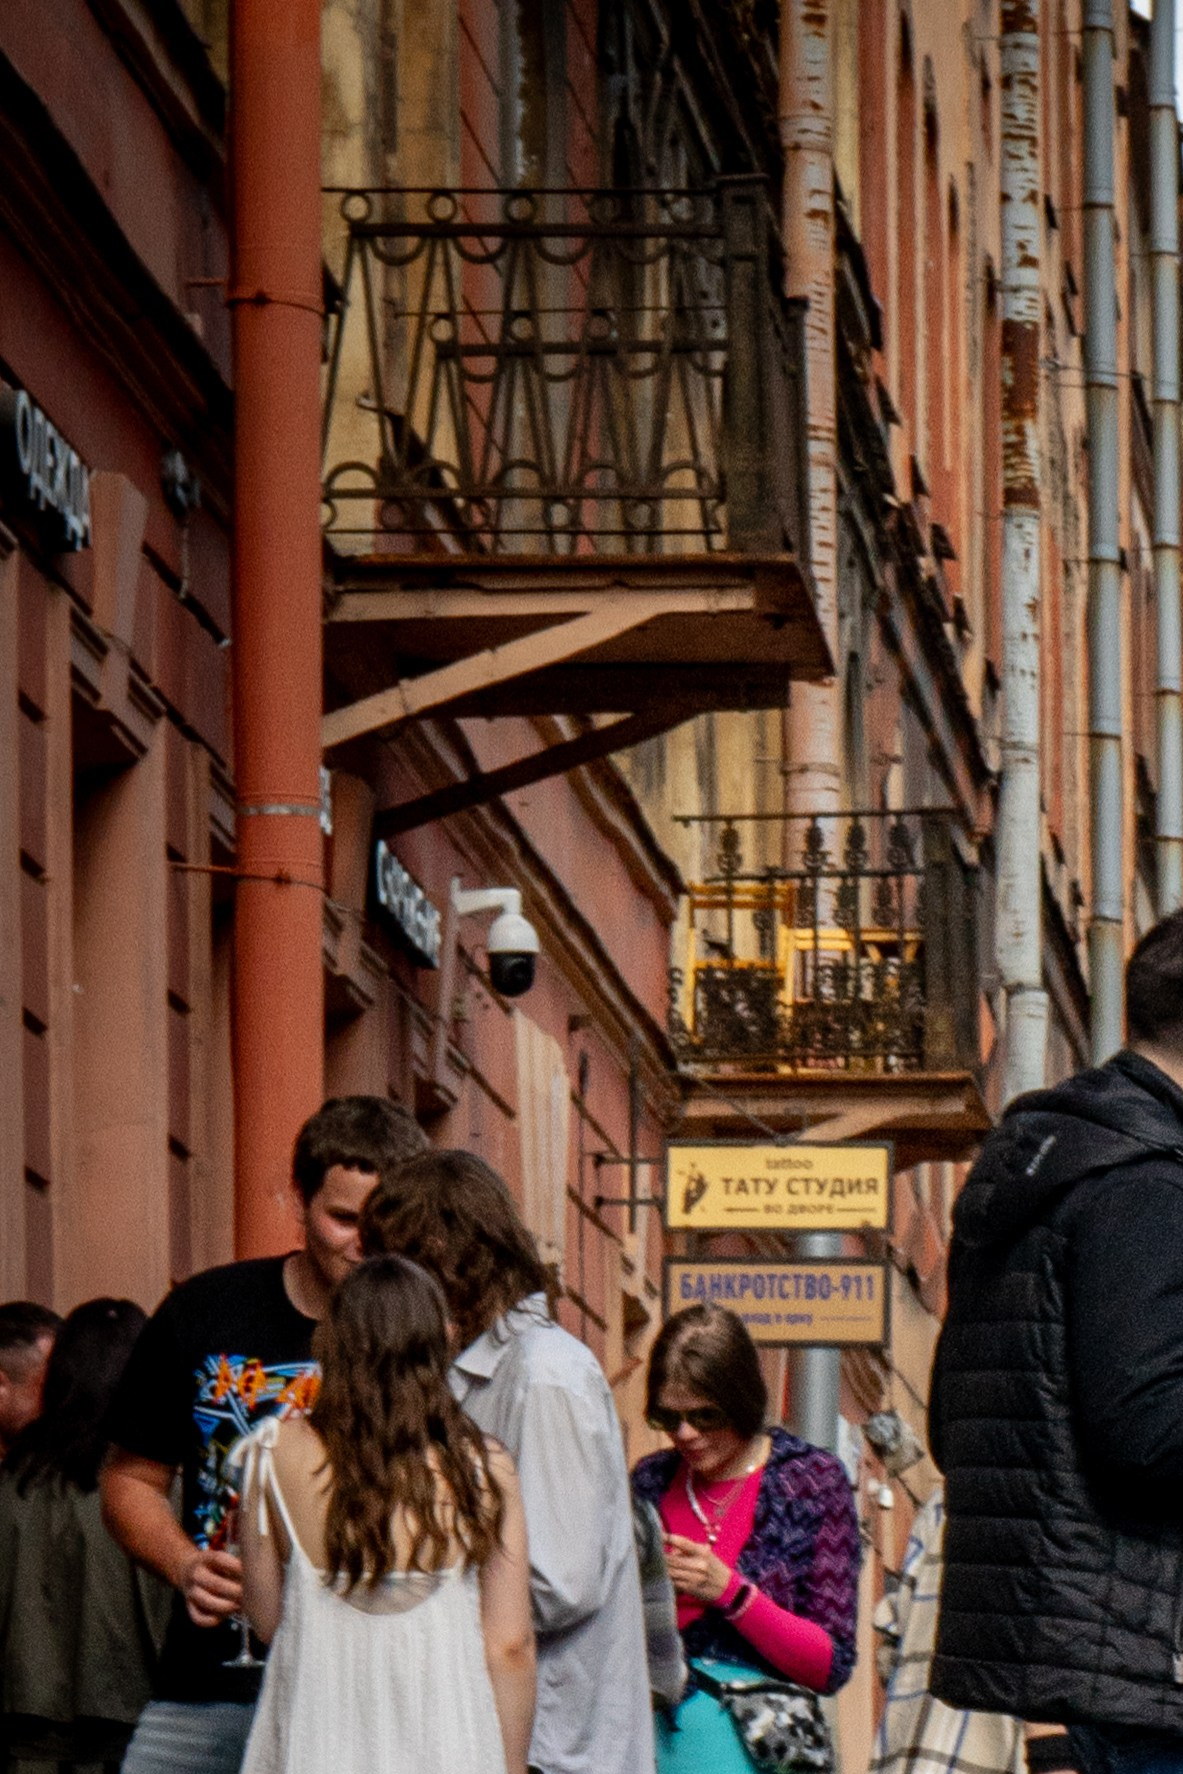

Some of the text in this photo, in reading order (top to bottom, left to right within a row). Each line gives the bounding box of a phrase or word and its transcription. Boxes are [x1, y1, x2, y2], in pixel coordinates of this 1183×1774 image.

[720, 1177, 879, 1199] ТАТУ СТУДИЯ
[679, 1272, 876, 1301] БАНКРОТСТВО-911
